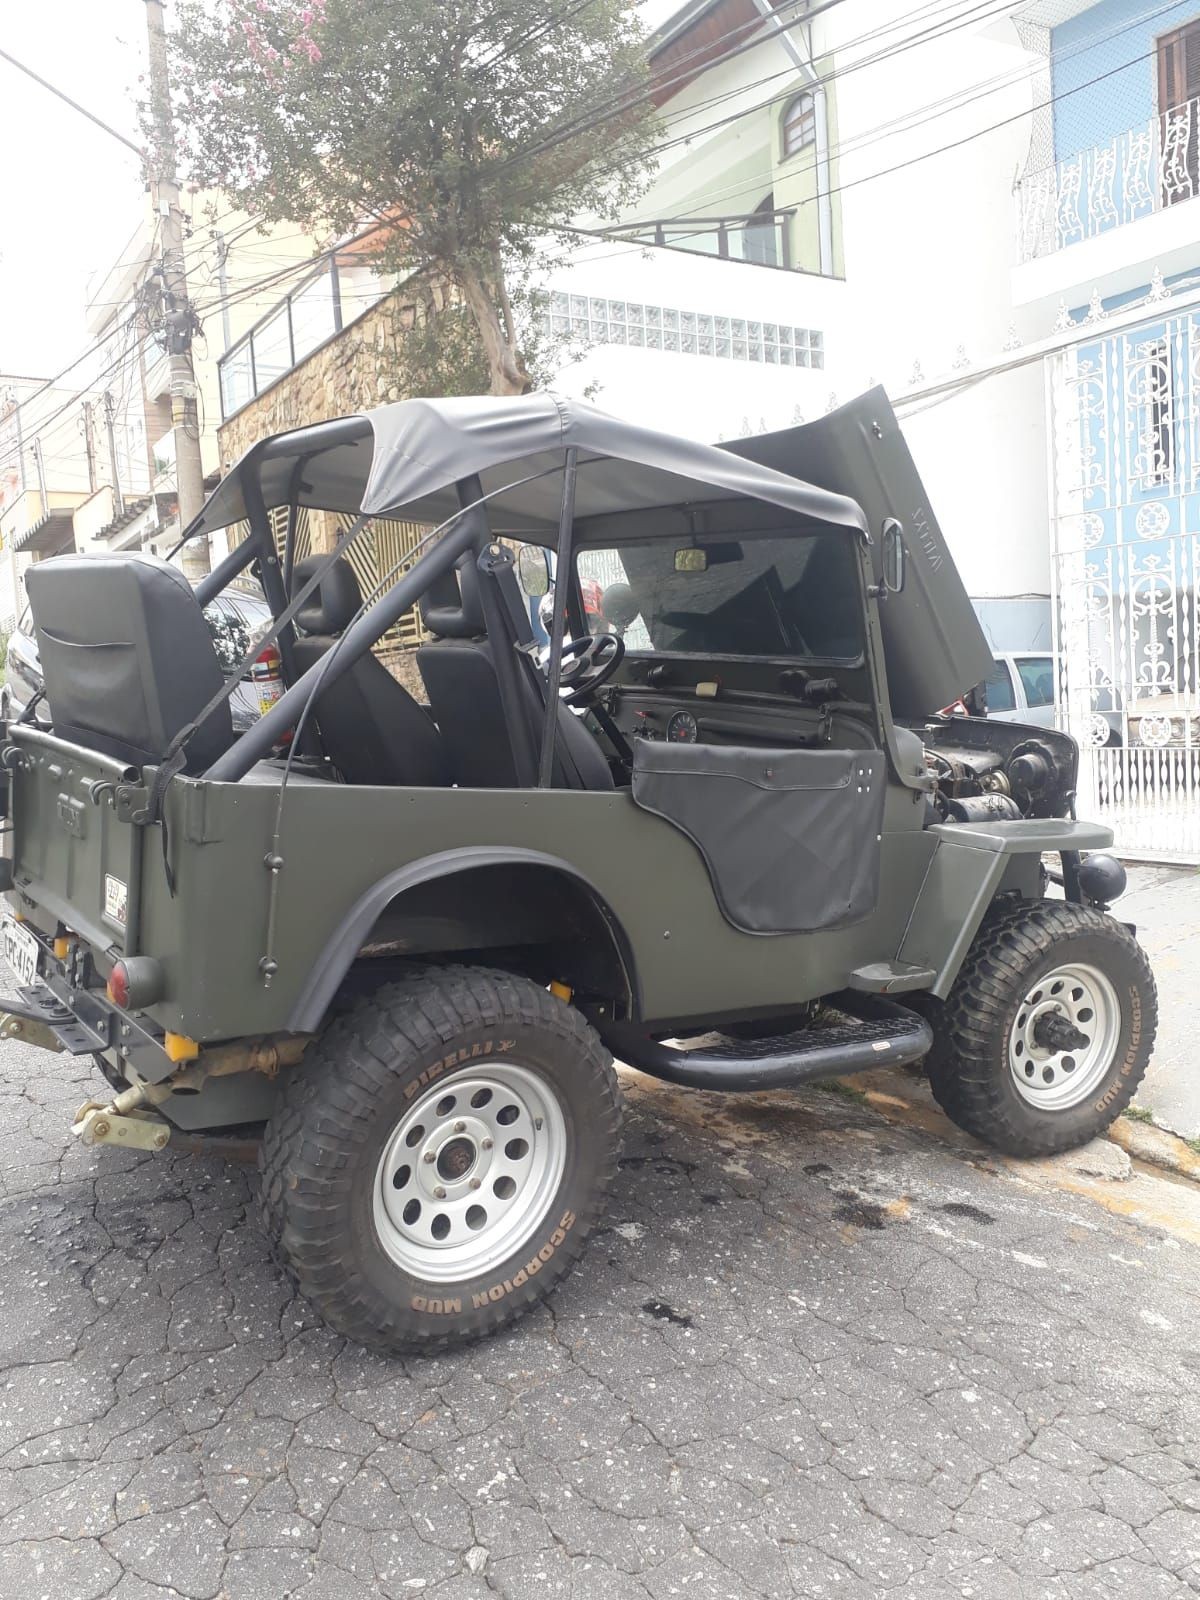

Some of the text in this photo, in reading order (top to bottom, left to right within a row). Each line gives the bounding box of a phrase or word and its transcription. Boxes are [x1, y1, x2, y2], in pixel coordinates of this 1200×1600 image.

[403, 1040, 493, 1099] PIRELLI
[1096, 985, 1141, 1113] SCORPION MUD
[411, 1210, 576, 1315] SCORPION MUD
